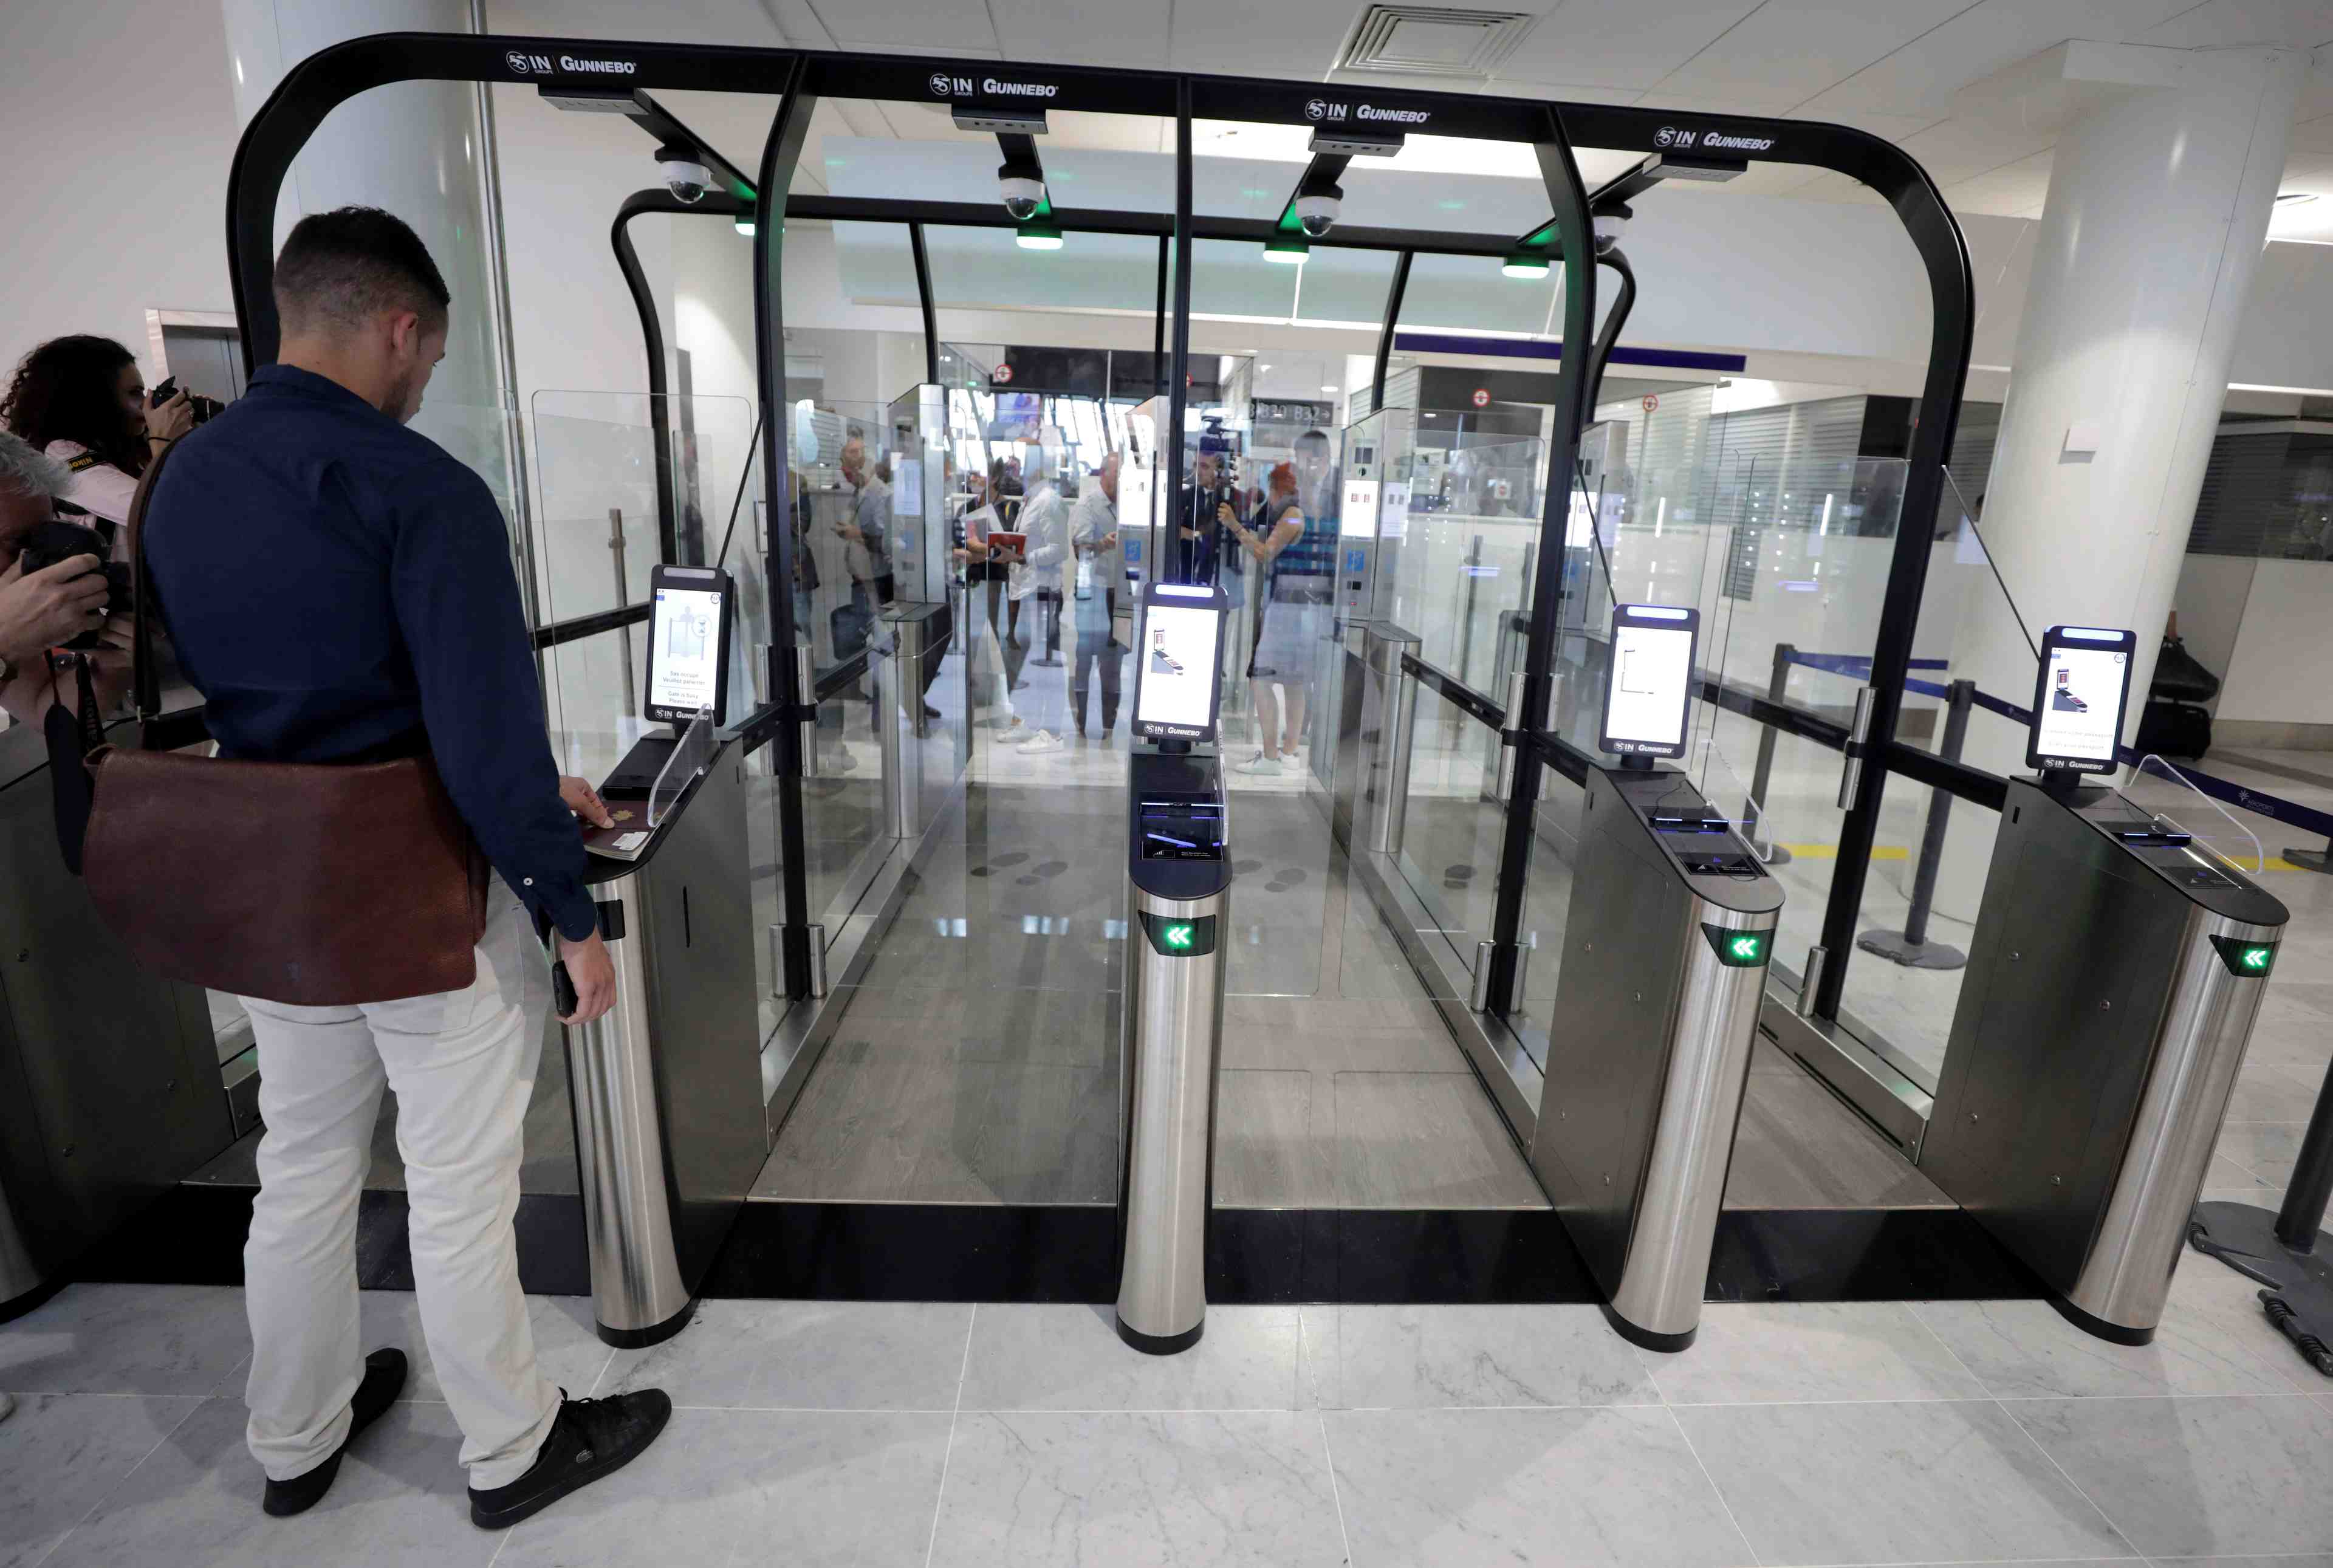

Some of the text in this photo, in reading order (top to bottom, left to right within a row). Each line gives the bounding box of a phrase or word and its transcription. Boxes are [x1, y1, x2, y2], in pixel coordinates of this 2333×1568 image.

[529, 55, 635, 74] IN GUNNEBO
[953, 78, 1056, 97] IN GUNNEBO
[1328, 104, 1428, 123] IN GUNNEBO
[1675, 131, 1772, 150] IN GUNNEBO
[676, 711, 709, 721] GUNNBO
[2069, 761, 2103, 770] GUNNEBO
